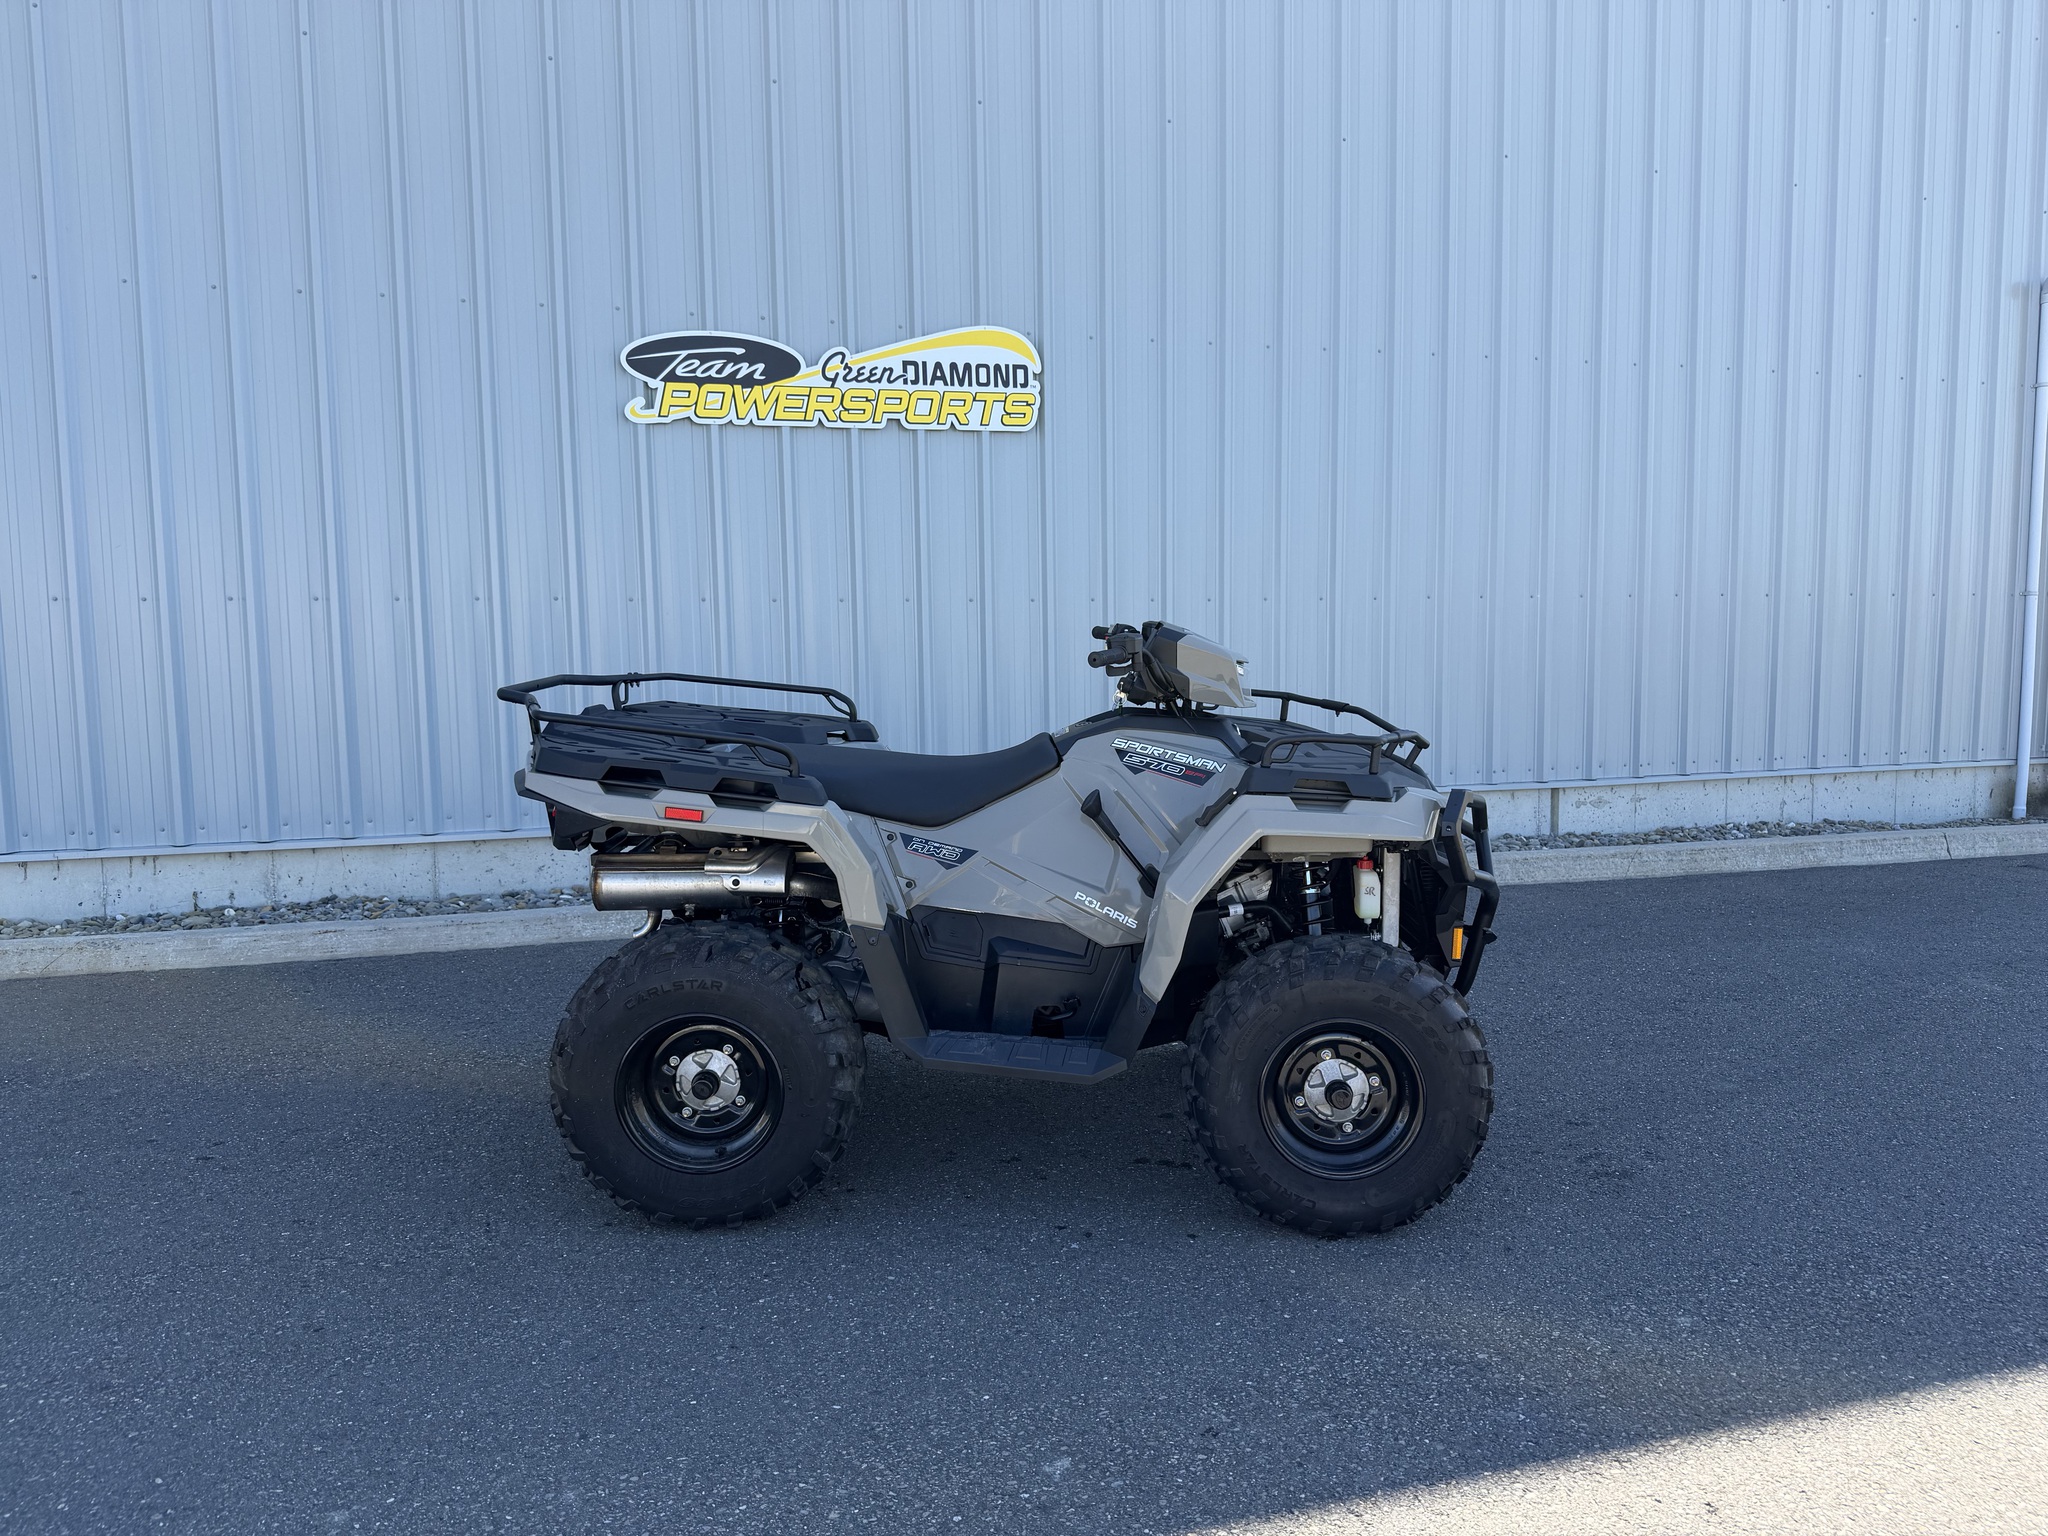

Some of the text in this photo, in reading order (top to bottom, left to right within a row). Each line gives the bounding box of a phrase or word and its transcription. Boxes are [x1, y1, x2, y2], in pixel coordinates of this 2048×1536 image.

[628, 347, 767, 382] Team
[821, 351, 1030, 389] Green DIAMOND
[658, 382, 1037, 427] POWERSPORTS
[1110, 737, 1228, 773] SPORTSMAN
[1122, 753, 1186, 777] 570
[907, 841, 961, 861] AWD
[927, 841, 964, 853] DEMAND
[1074, 891, 1138, 929] POLARIS
[624, 978, 724, 1009] CARLSTAR
